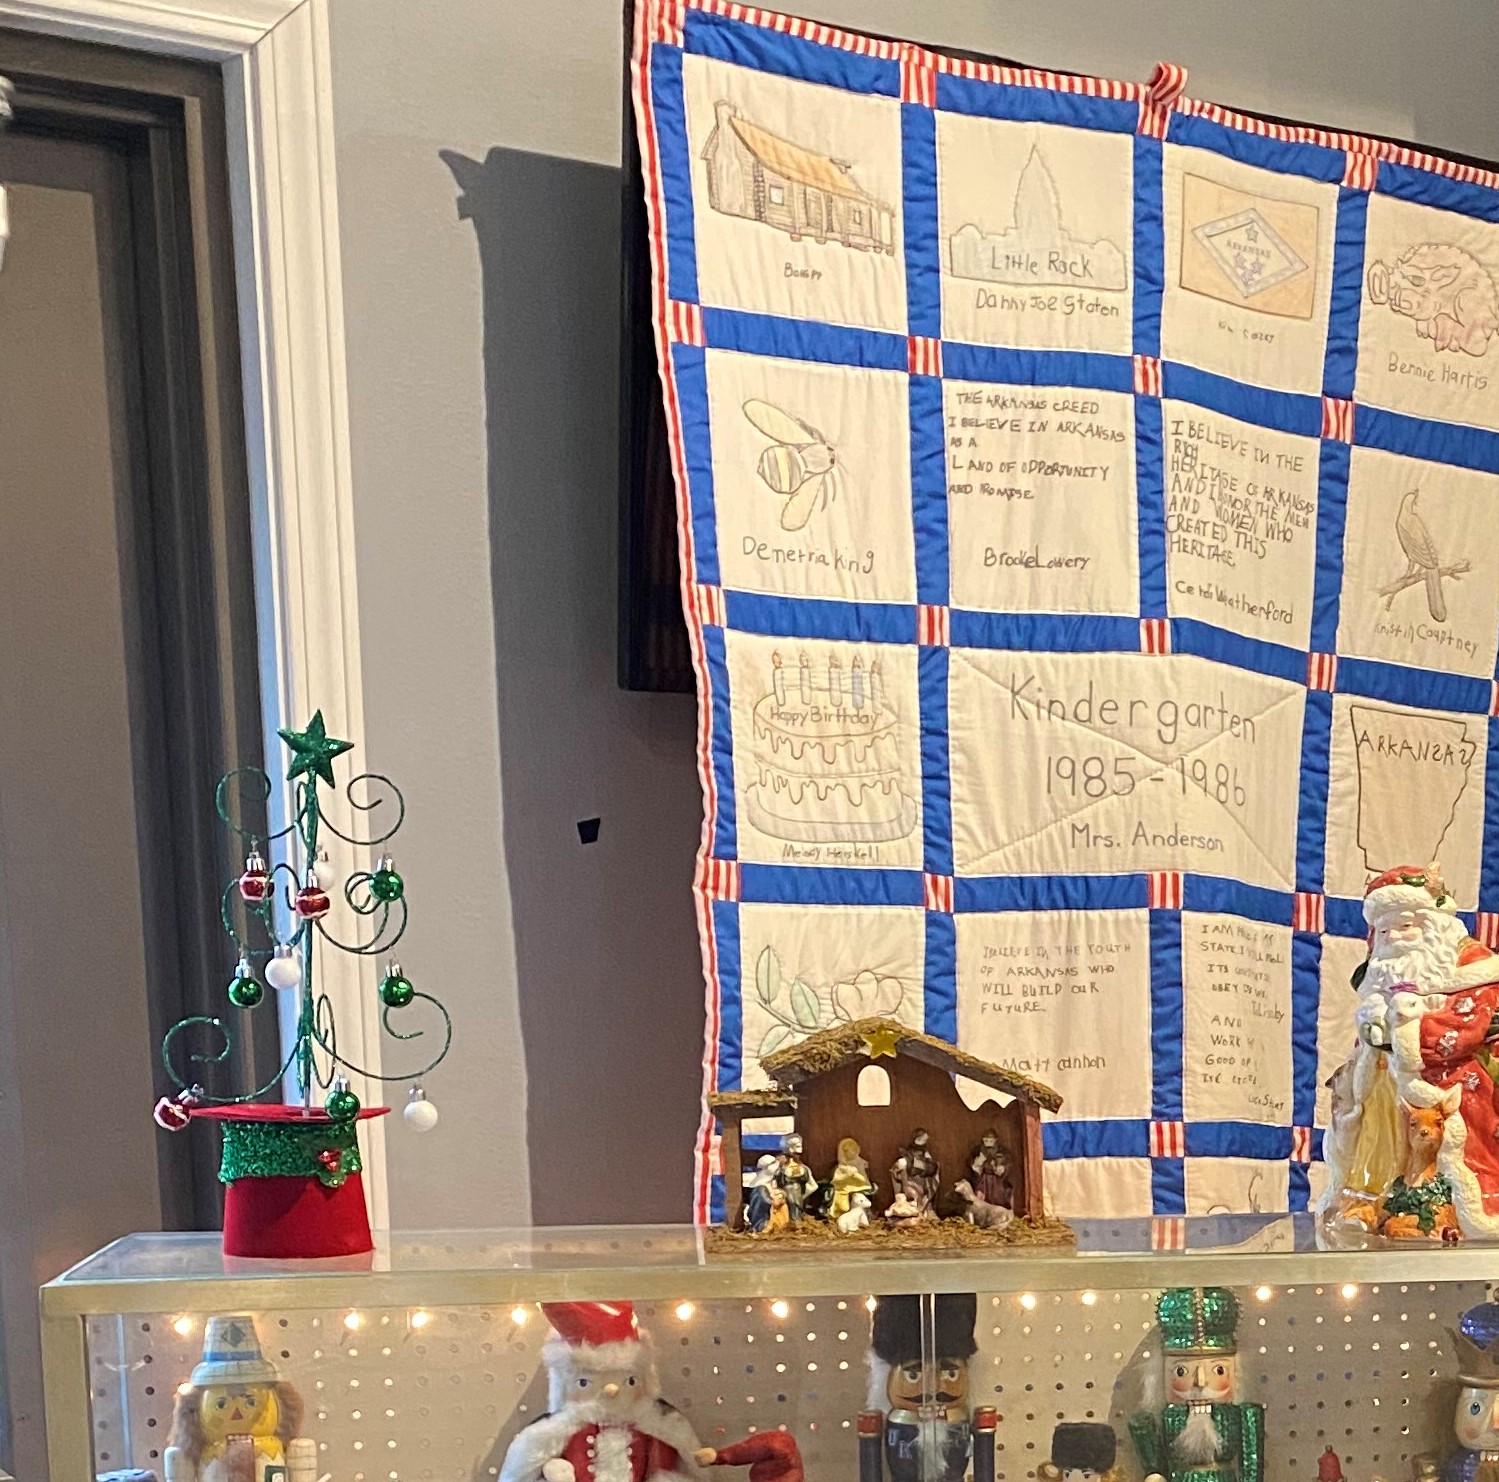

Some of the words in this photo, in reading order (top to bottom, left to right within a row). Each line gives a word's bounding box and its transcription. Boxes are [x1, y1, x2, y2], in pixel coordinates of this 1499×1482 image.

[991, 246, 1038, 275] Little
[1048, 251, 1093, 278] Rock
[976, 288, 1027, 312] Danny
[1030, 296, 1057, 311] Joe
[1388, 352, 1436, 382] Bernie
[956, 390, 983, 405] THE
[1053, 401, 1100, 415] CREED
[948, 416, 957, 428] I
[961, 418, 1021, 433] BELIEVE
[1027, 420, 1049, 433] IN
[1056, 421, 1126, 443] ARKANSAS
[950, 436, 963, 447] AS
[968, 437, 979, 448] A
[1171, 420, 1184, 436] I
[1188, 421, 1249, 457] BELIEVE
[1254, 447, 1270, 465] IN
[1276, 454, 1304, 473] THE
[999, 461, 1017, 474] OF
[1021, 460, 1110, 481] OPPORTUNITY
[1172, 473, 1207, 495] AND
[1255, 501, 1278, 522] THE
[1284, 505, 1309, 530] MEN
[1168, 495, 1200, 515] AND
[1266, 524, 1294, 544] WHO
[1166, 514, 1229, 544] CREATED
[1234, 530, 1267, 560] THIS
[770, 706, 809, 728] Happy
[810, 704, 879, 731] Birthday
[1009, 672, 1256, 745] Kindergarten
[1071, 822, 1122, 850] Mrs.
[1131, 821, 1226, 853] Anderson
[1201, 924, 1209, 934] I
[1211, 923, 1234, 938] AM
[1054, 945, 1081, 956] THE
[1087, 943, 1132, 955] YOUTH
[980, 966, 995, 976] OF
[1006, 965, 1079, 979] ARKANSAS
[1088, 964, 1115, 975] WHO
[981, 982, 1013, 996] WILL
[1021, 982, 1063, 998] BUILD
[1070, 981, 1100, 995] OUR
[1204, 1053, 1237, 1066] GOOD
